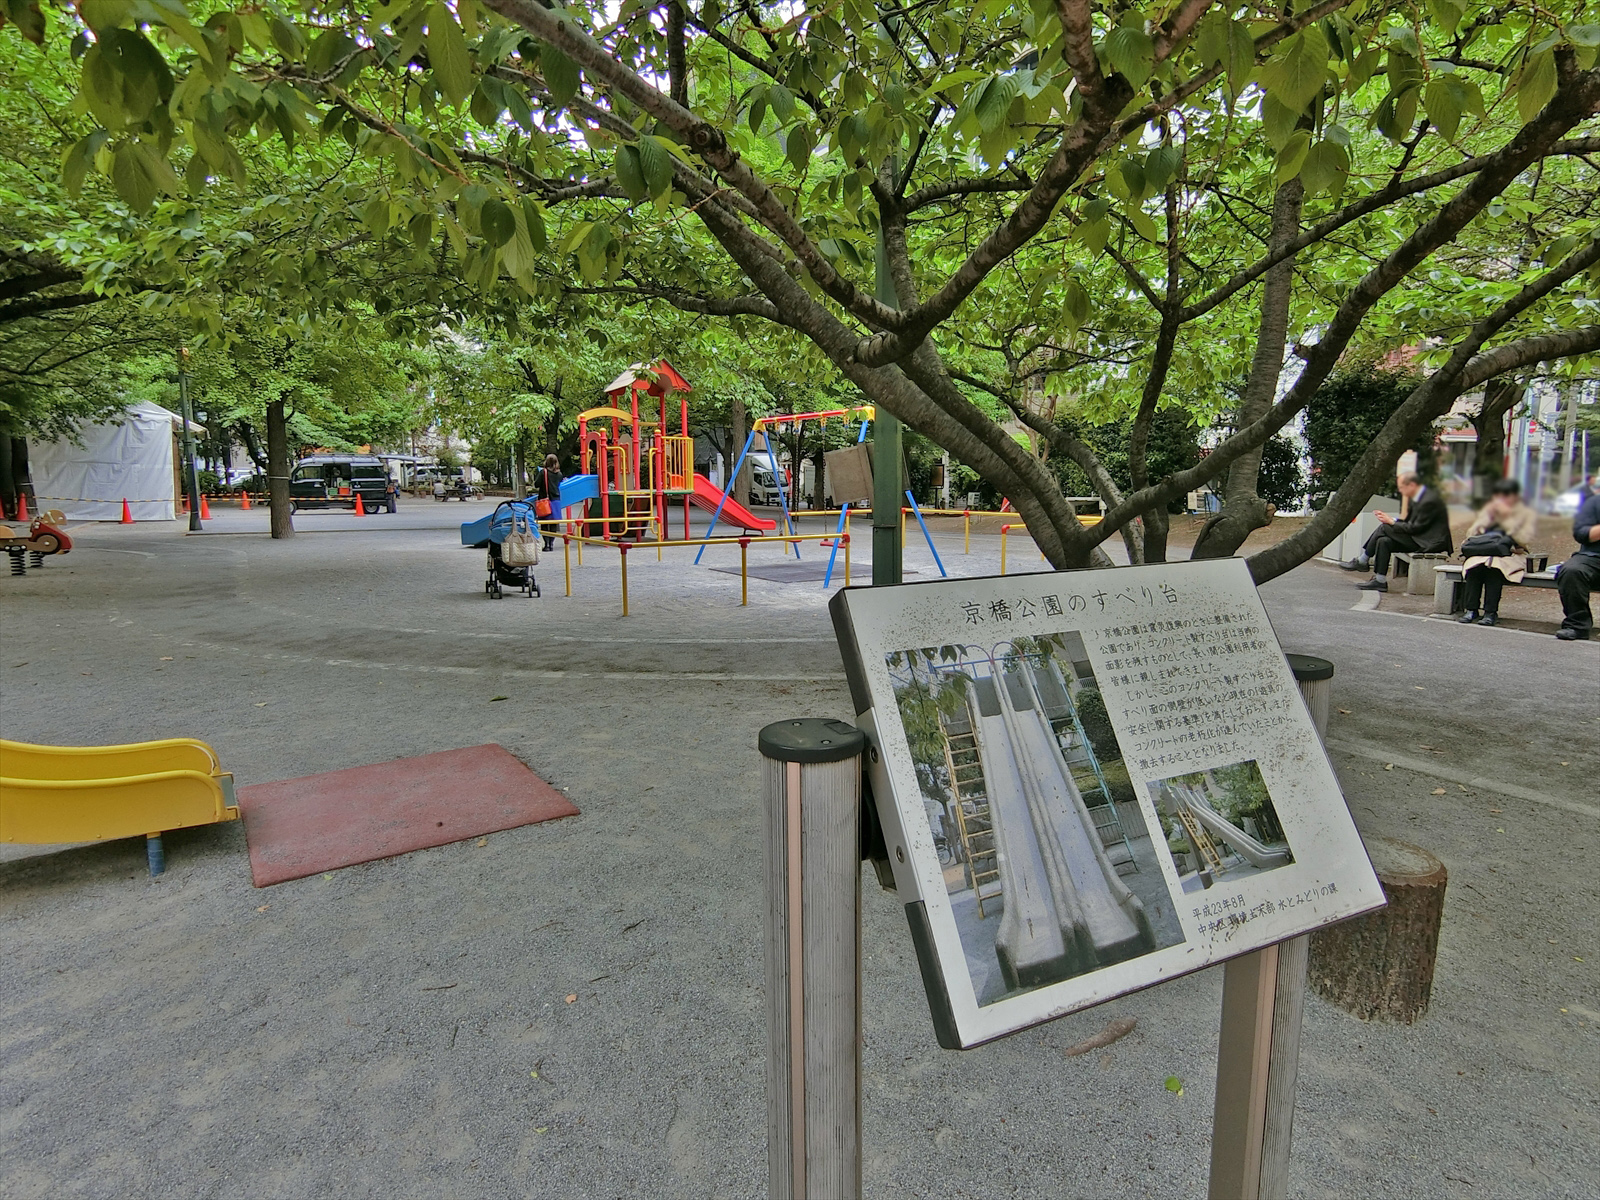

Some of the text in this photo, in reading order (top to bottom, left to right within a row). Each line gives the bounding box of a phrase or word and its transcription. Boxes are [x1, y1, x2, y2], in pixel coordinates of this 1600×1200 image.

[961, 585, 1179, 625] 京橋公園のすべり台
[1103, 612, 1255, 638] 京橋公園は震災復興のときに整備された
[1100, 626, 1260, 655] 公園であり、コンクリート製すべり台は当時の
[1105, 640, 1266, 671] 面影を残すものとして、長い間公園利用者の
[1110, 662, 1221, 687] 皆様に親しまれてきました。
[1139, 740, 1245, 770] 撤去することとなりました。
[1192, 893, 1246, 920] 平成23年8月
